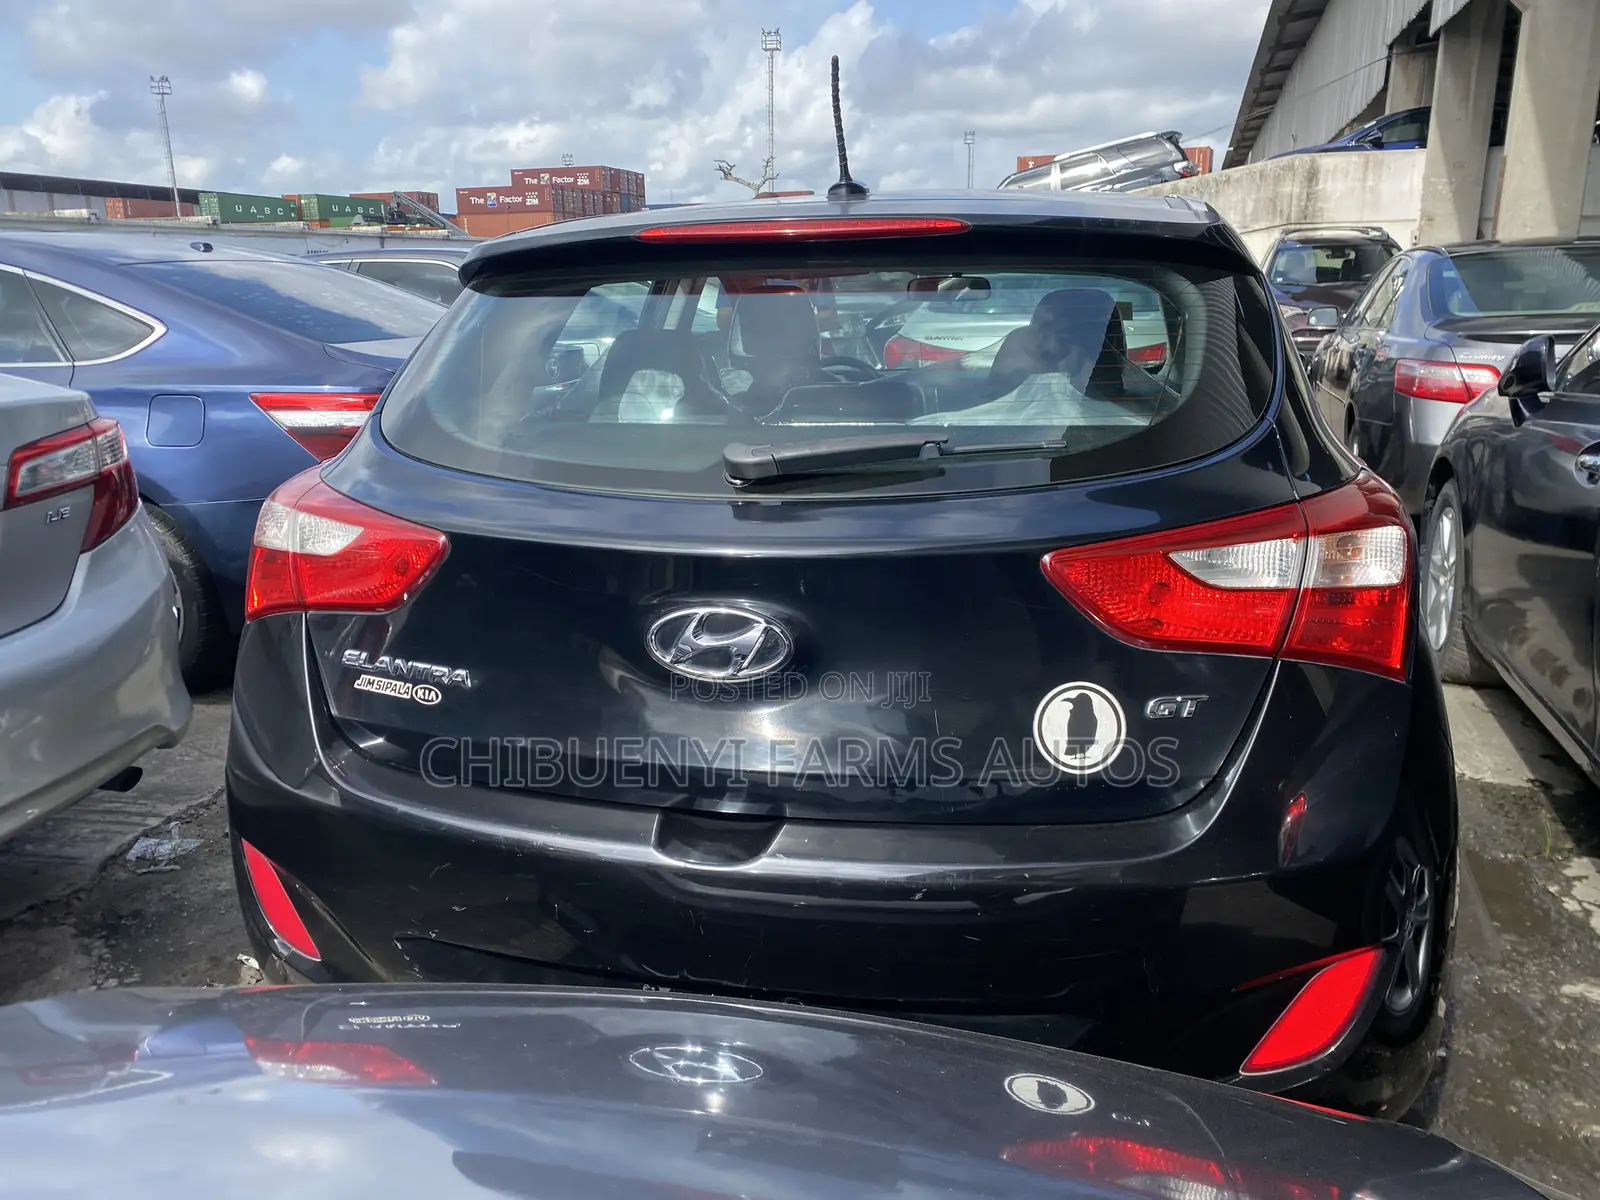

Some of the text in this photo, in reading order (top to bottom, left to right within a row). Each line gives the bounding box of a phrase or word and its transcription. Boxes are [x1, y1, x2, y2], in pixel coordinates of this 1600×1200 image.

[524, 177, 538, 185] The
[552, 176, 575, 184] Factor
[470, 196, 485, 204] The
[499, 195, 523, 204] Factor
[235, 203, 284, 215] UASC
[331, 204, 375, 215] UASC
[46, 506, 70, 524] LE
[342, 650, 471, 688] ELANTRA
[417, 689, 437, 701] KIA
[1146, 695, 1209, 718] GT
